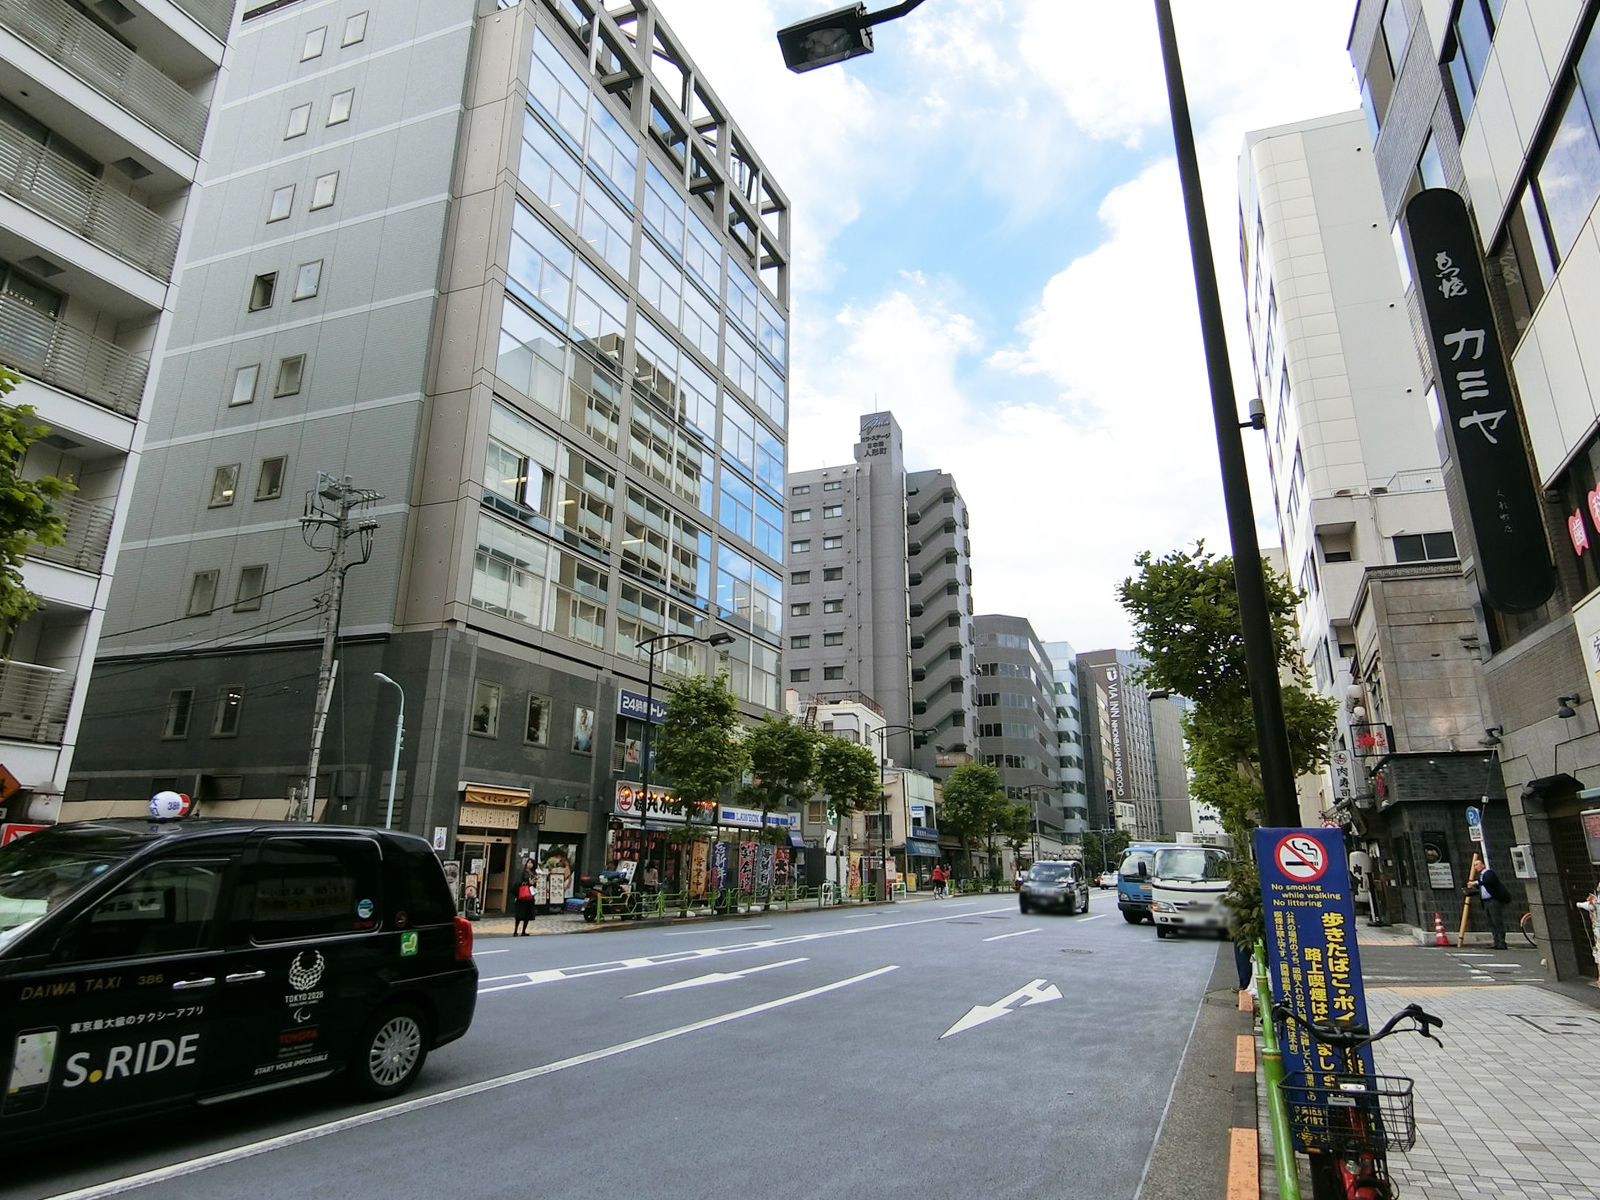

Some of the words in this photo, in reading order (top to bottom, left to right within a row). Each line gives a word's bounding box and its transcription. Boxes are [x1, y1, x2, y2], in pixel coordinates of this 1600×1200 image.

[1443, 327, 1507, 444] カミヤ
[863, 447, 887, 458] 人形町
[1108, 684, 1117, 699] VIA
[1110, 699, 1121, 717] INN
[1336, 767, 1351, 800] 肉寿司
[1286, 884, 1322, 892] smoking
[1307, 892, 1341, 900] walking
[1288, 899, 1322, 908] littering
[20, 981, 76, 1000] DAIWA
[85, 976, 122, 992] TAXI
[137, 974, 164, 986] 386
[285, 992, 307, 1003] TOKYO
[308, 991, 324, 999] 2020
[69, 1005, 204, 1034] 東京最大級のタクシーアプリ
[254, 1065, 275, 1076] START
[276, 1061, 293, 1071] YOUR
[293, 1053, 329, 1067] IMPOSSIBLE
